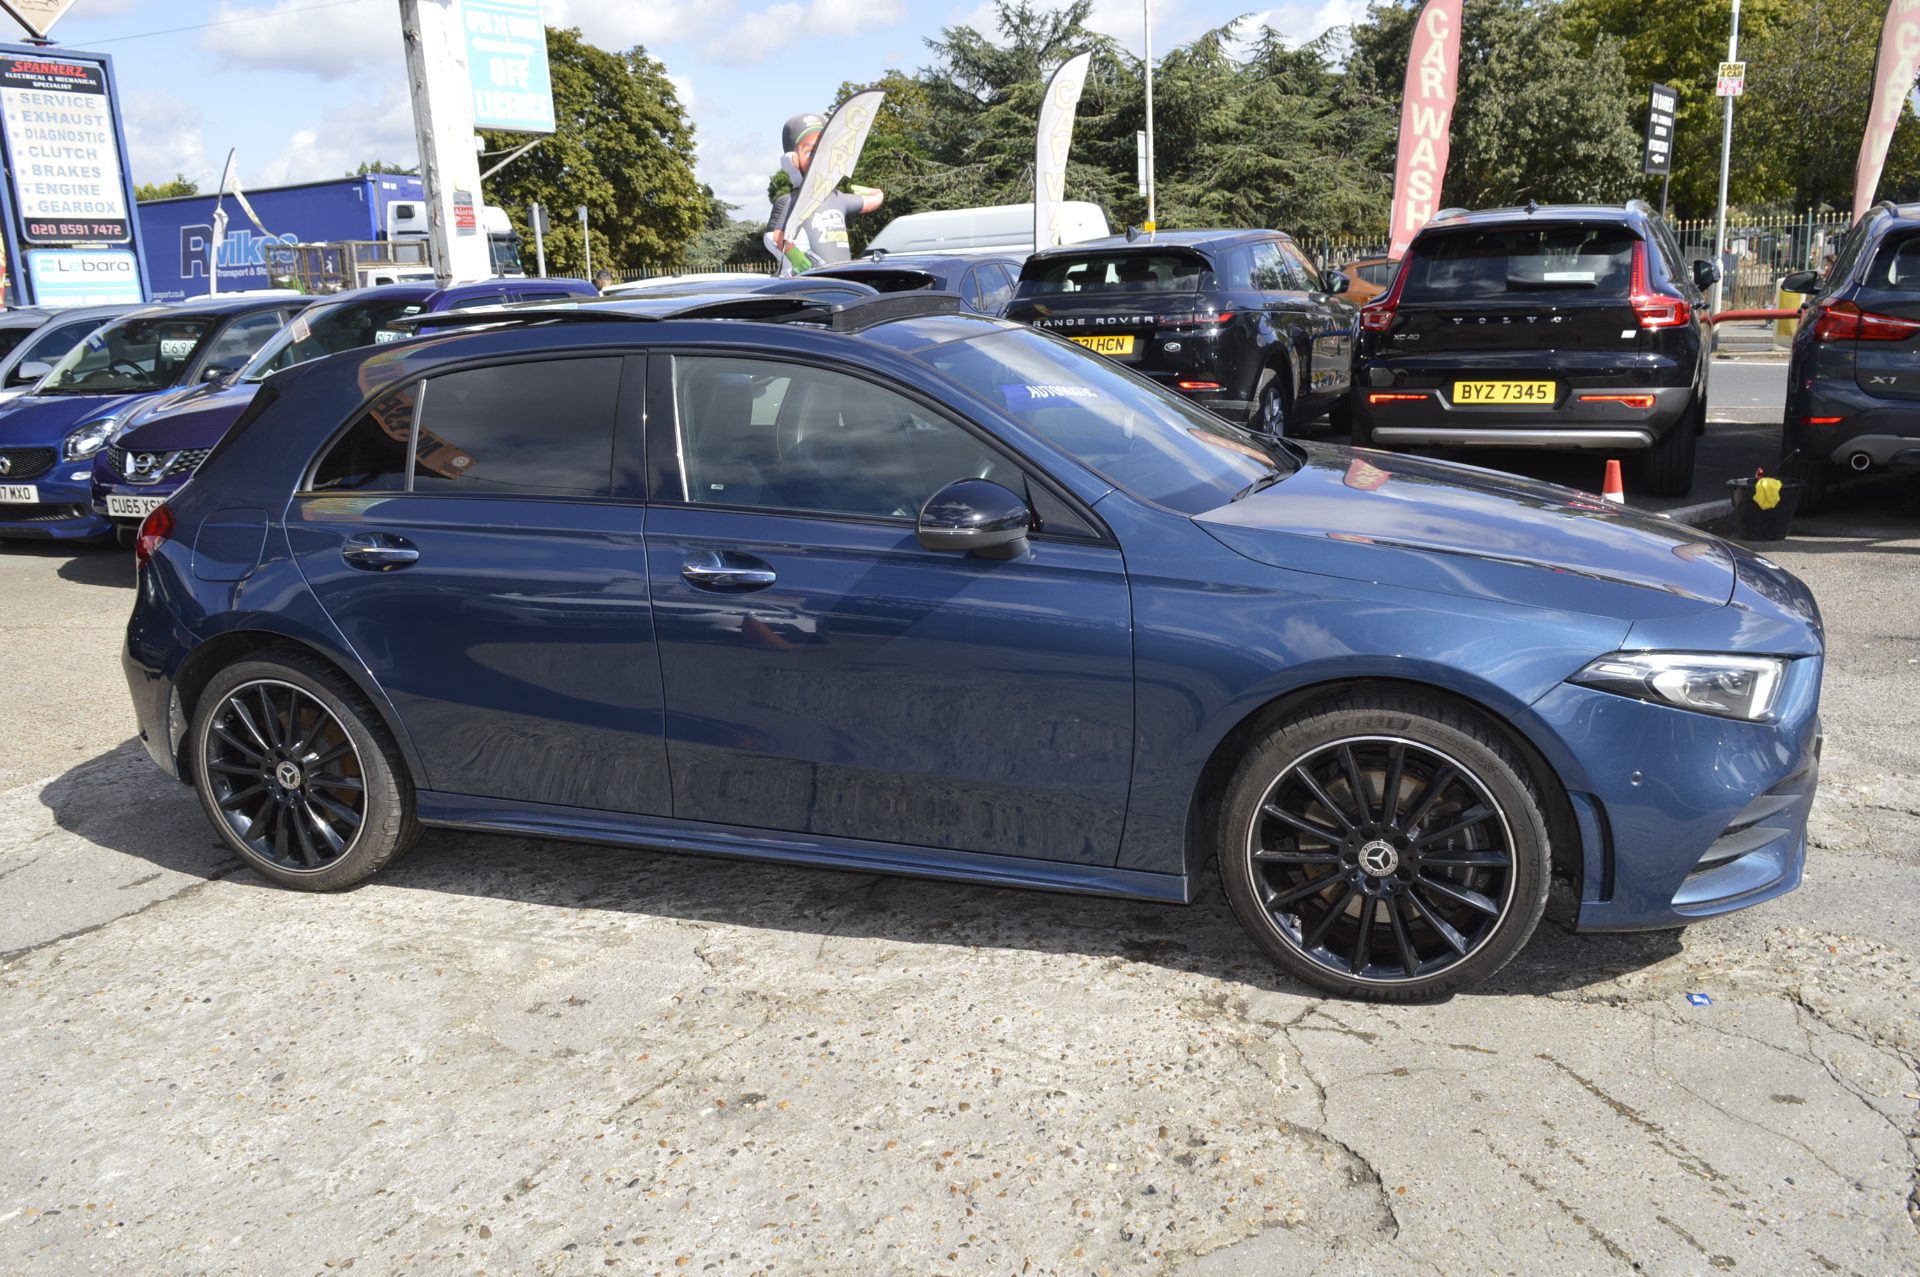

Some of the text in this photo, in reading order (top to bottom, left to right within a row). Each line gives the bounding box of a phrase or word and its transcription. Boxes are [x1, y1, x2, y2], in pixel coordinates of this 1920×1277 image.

[11, 61, 87, 78] SPANNERZ
[489, 57, 530, 88] OFF
[32, 81, 72, 90] SPECIALIST
[20, 92, 96, 109] SERVICE
[474, 89, 552, 121] LICENCE
[22, 110, 104, 127] EXHAUST
[1405, 8, 1449, 231] CAR WASH
[25, 128, 106, 144] DIAGNOSTIC
[28, 146, 98, 161] CLUTCH
[31, 164, 101, 179] BRAKES
[35, 183, 100, 197] ENGINE
[38, 200, 117, 214] GEARBOX
[31, 224, 122, 235] 020 8591 7472
[58, 259, 130, 272] Lebara
[216, 269, 248, 279] Transport
[1033, 316, 1154, 327] RANGE ROVER
[1453, 317, 1562, 325] VOLVO
[1096, 338, 1124, 351] HCN
[1869, 375, 1897, 384] X1
[1461, 384, 1547, 400] BYZ 7345
[111, 498, 141, 514] CU65
